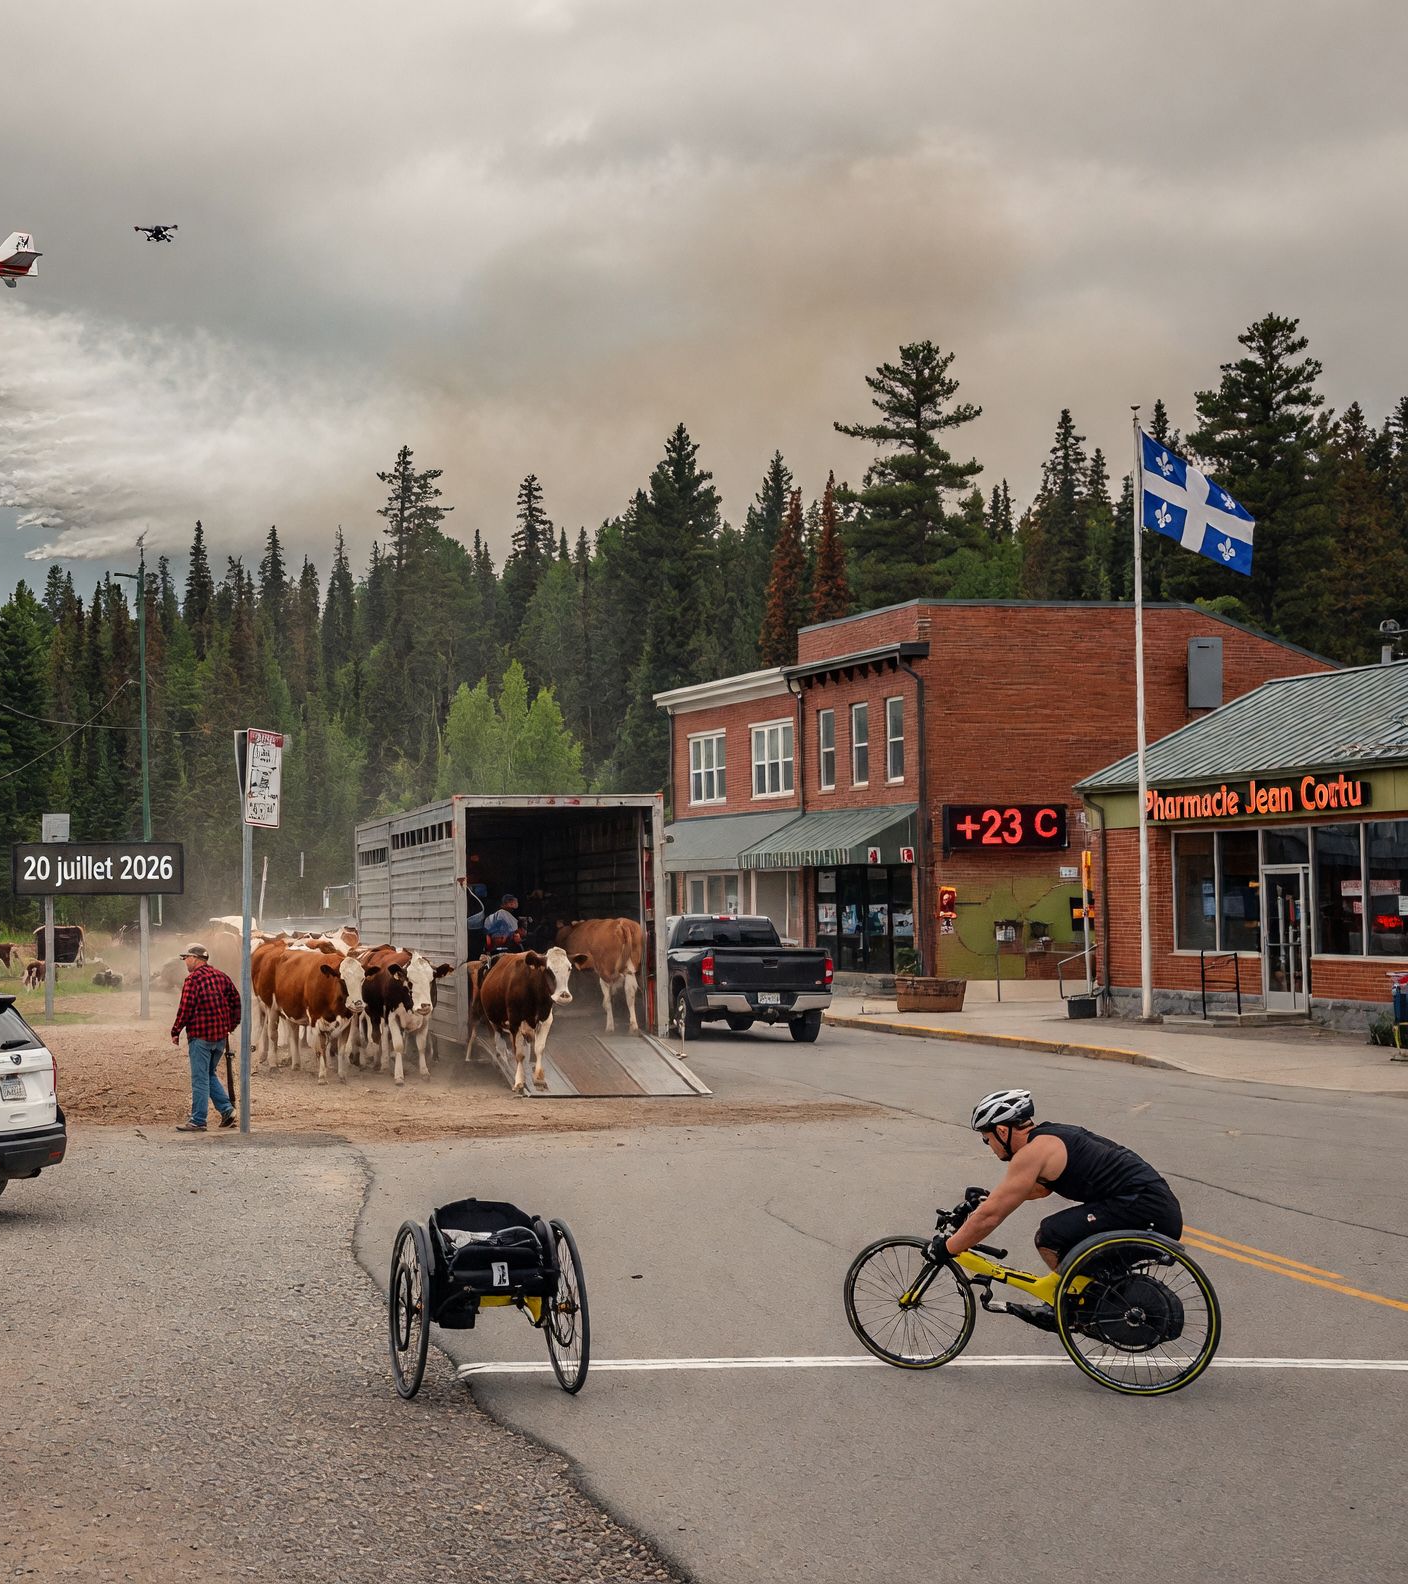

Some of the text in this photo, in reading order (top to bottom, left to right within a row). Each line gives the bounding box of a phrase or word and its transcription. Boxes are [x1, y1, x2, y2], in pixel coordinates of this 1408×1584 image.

[1145, 785, 1240, 820] Pharmacie
[1245, 780, 1293, 814] Jean
[956, 808, 1058, 844] +23 C
[23, 855, 173, 887] 20 juillet 2026
